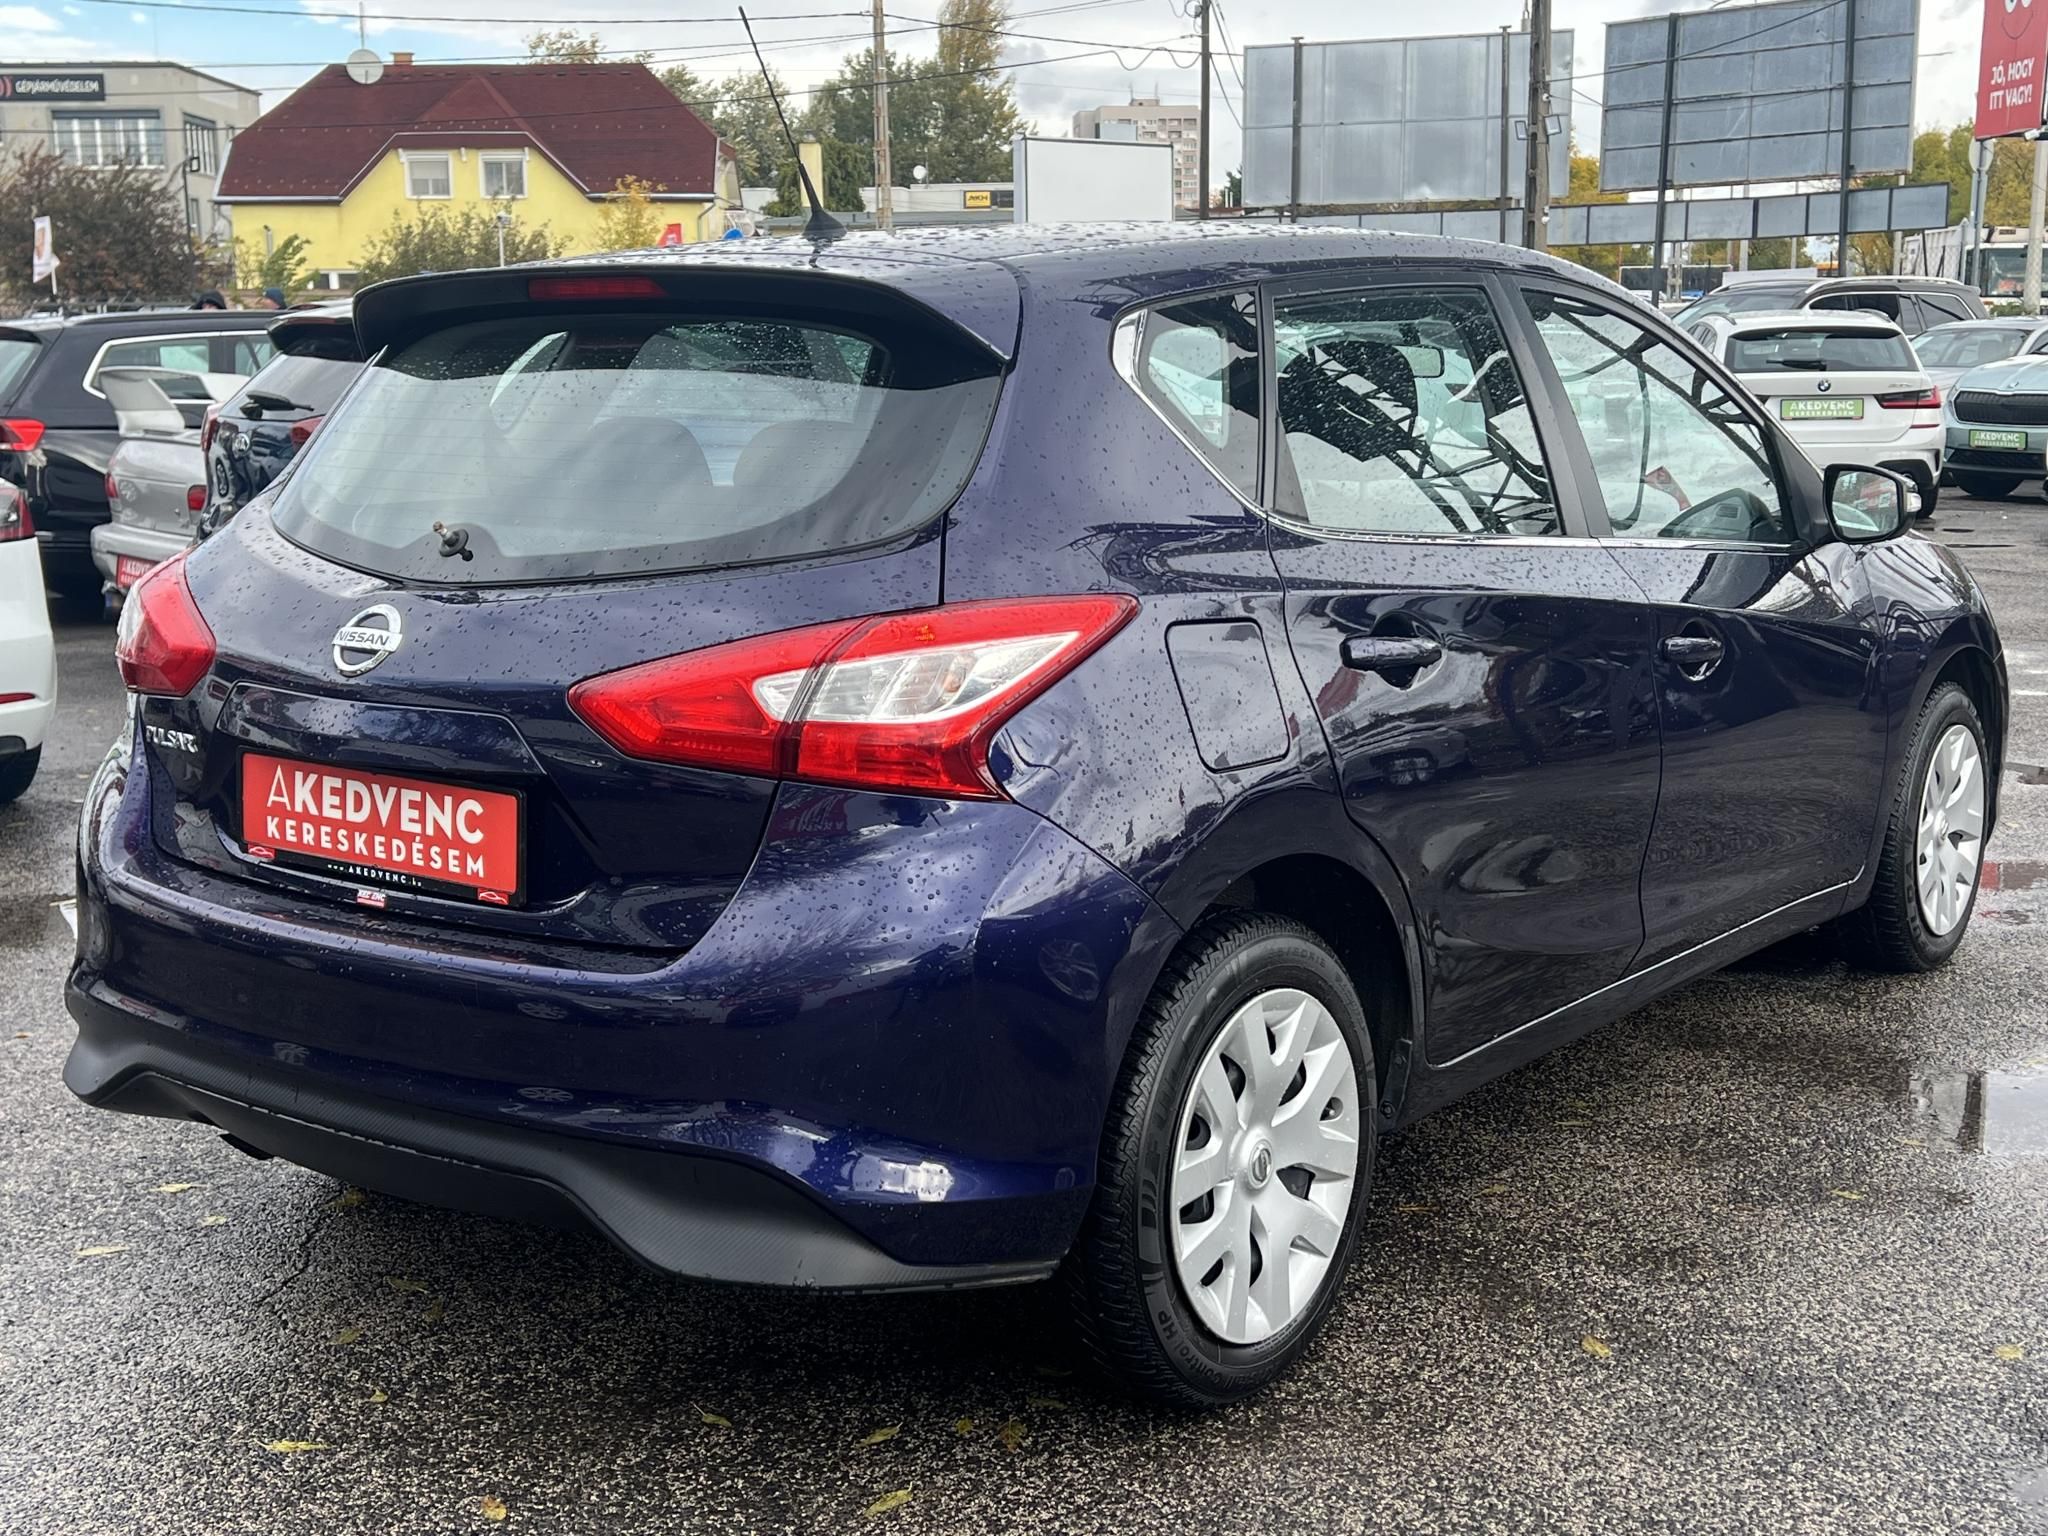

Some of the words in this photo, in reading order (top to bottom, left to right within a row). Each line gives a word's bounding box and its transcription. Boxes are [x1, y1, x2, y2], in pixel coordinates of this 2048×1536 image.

[1990, 59, 2006, 86] JÓ,
[2007, 57, 2035, 82] HOGY
[1989, 90, 2005, 111] ITT
[2005, 83, 2033, 107] VAGY!
[1789, 401, 1855, 410] AKEDVENC
[1975, 431, 2020, 442] AKEDVENC
[337, 631, 390, 646] NISSAN
[266, 764, 484, 844] AKEDVENC
[266, 815, 484, 878] KERESKEDÉSEM
